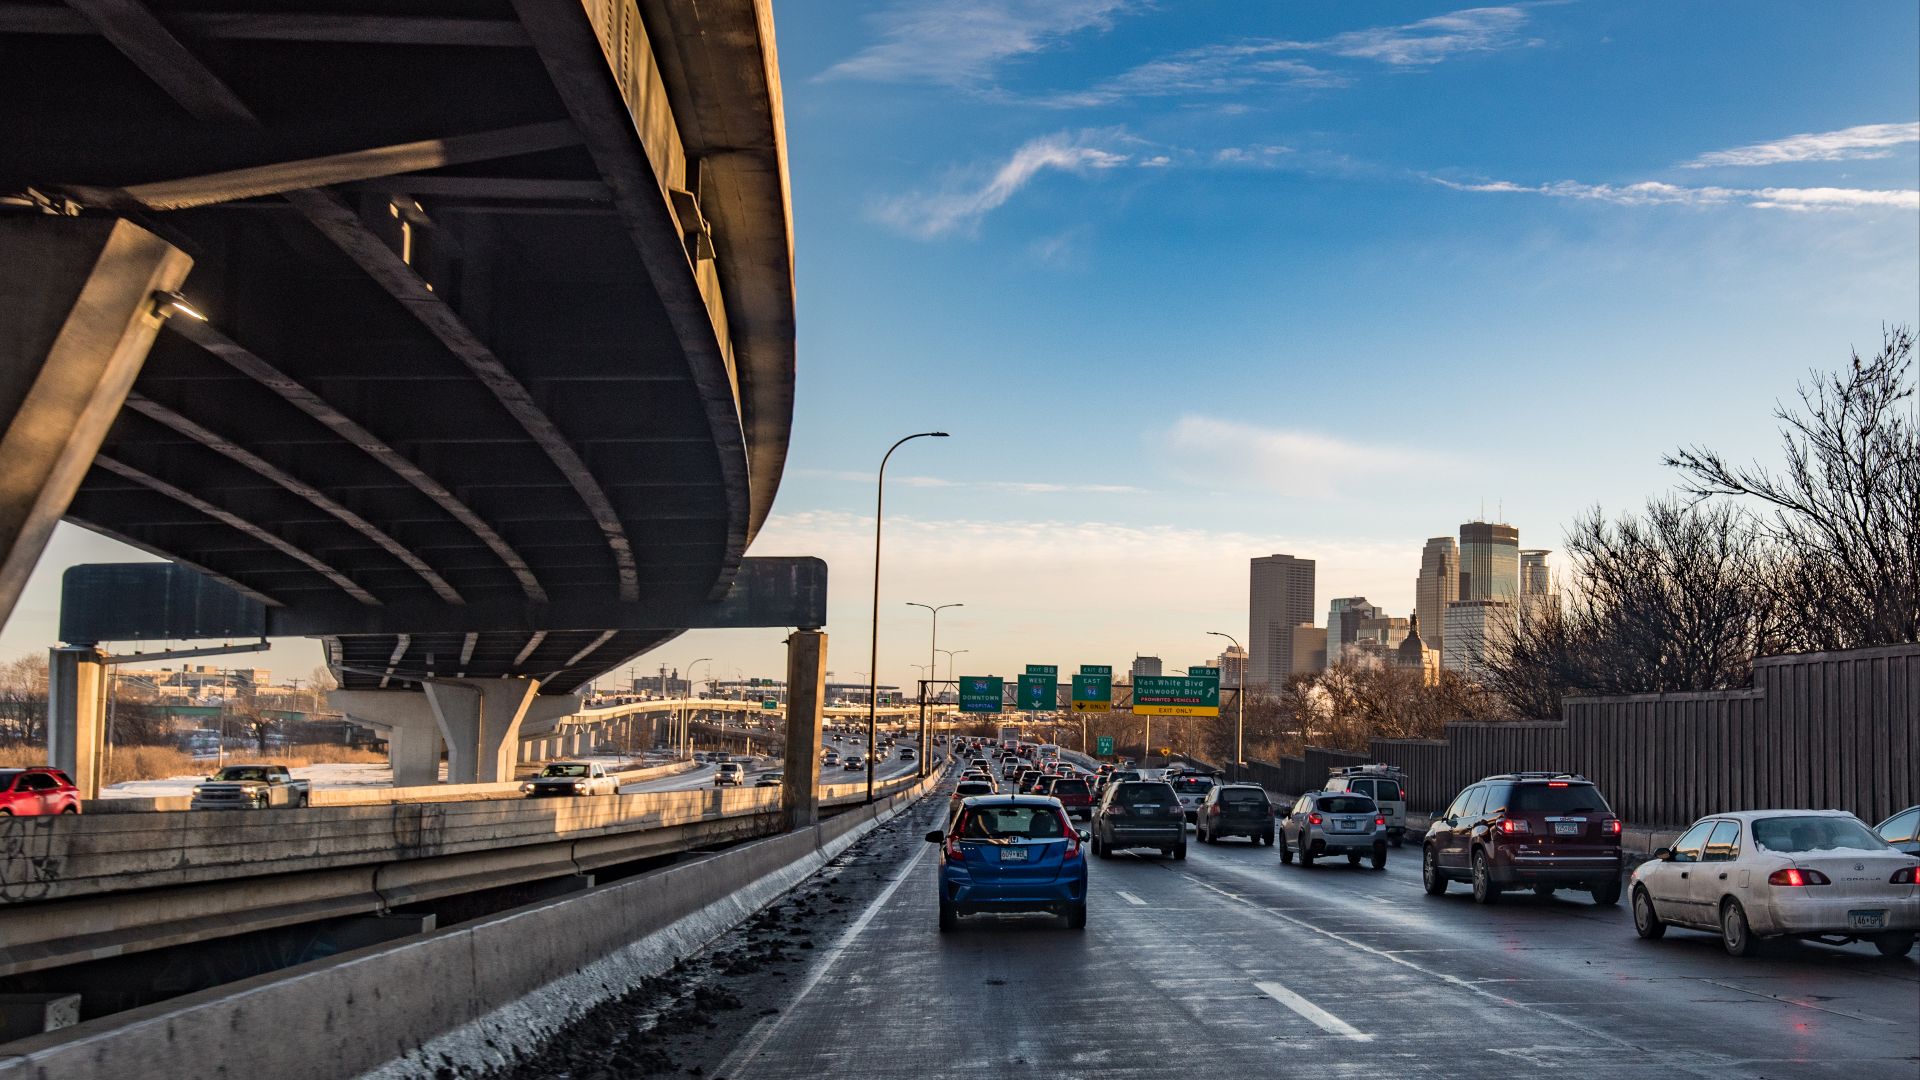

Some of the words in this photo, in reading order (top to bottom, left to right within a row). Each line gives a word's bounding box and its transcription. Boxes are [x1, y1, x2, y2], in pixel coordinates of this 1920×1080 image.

[974, 682, 987, 690] 394
[1158, 679, 1181, 687] White
[1087, 688, 1096, 696] 94
[1137, 688, 1180, 696] Dunwoody
[1184, 688, 1203, 696] Blvd
